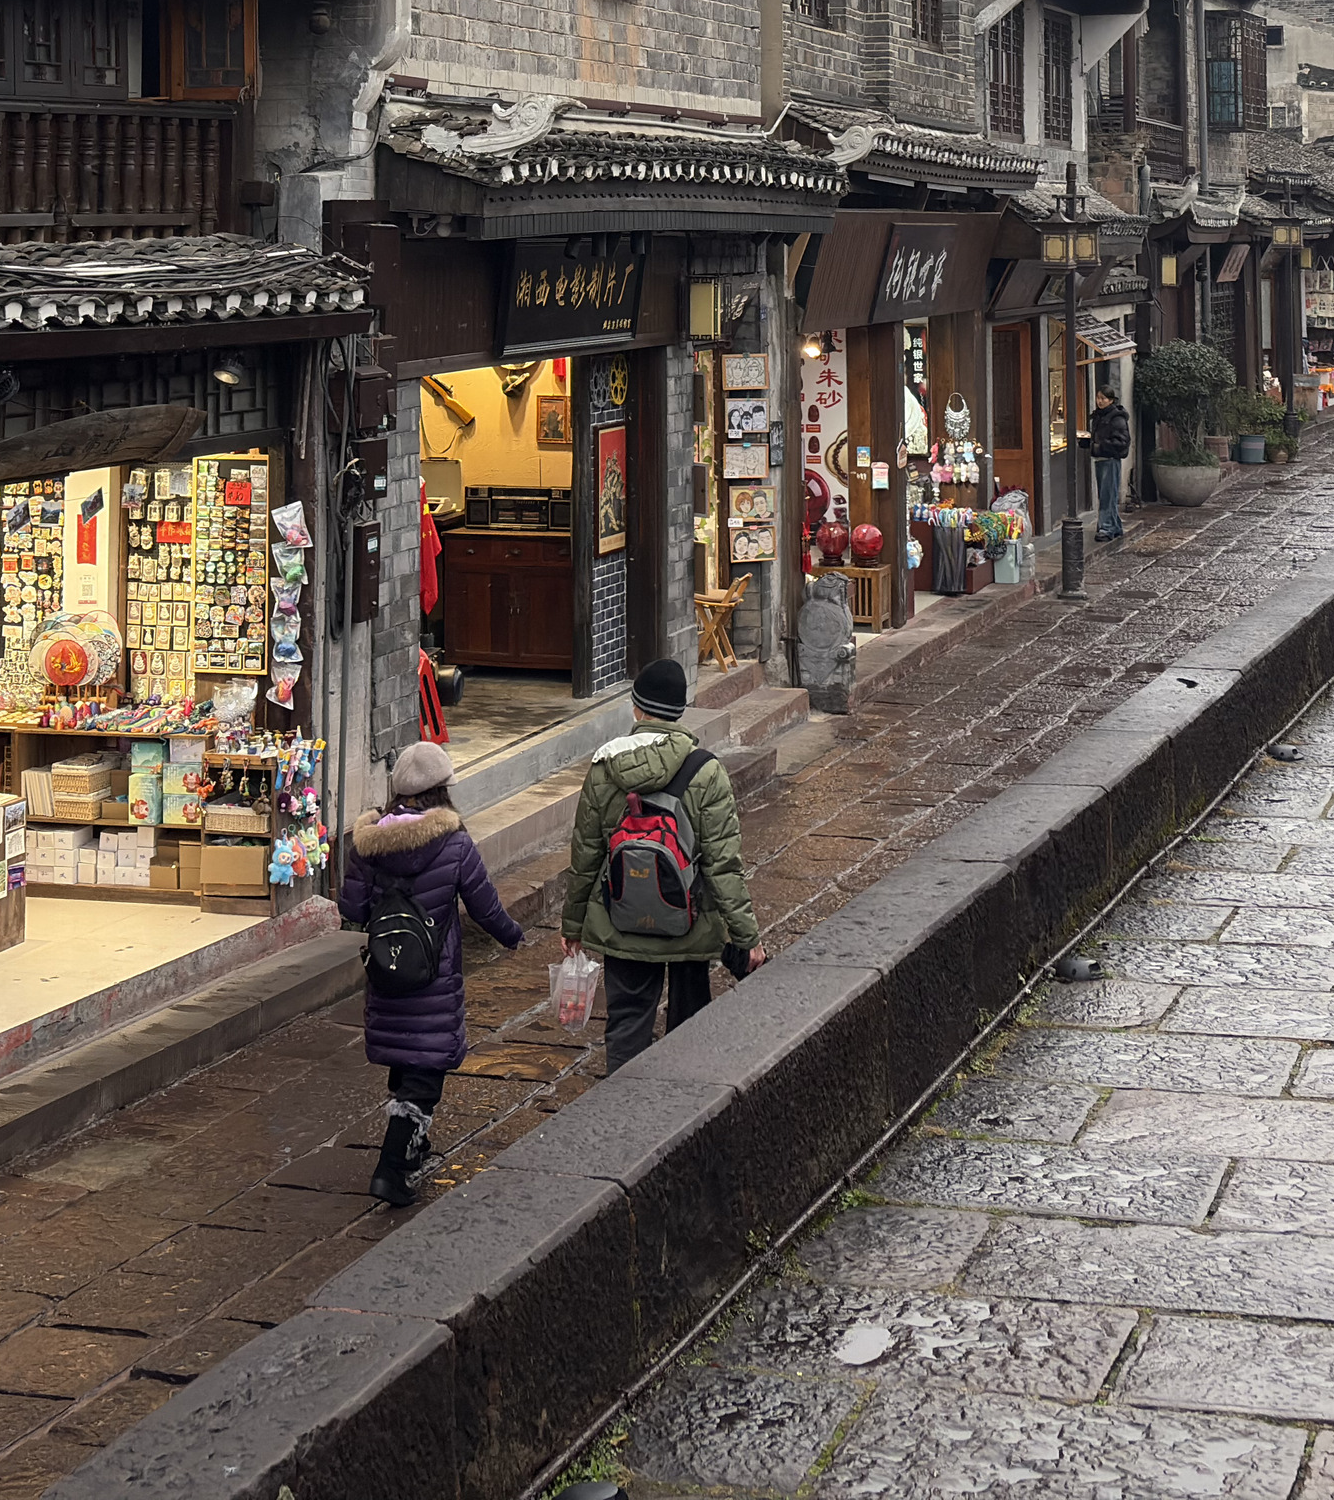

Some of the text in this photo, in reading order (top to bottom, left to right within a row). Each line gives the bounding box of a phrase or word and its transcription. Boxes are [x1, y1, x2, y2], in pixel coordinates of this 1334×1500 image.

[516, 260, 634, 311] 湘西电影制片厂
[912, 337, 924, 384] 纯银世家
